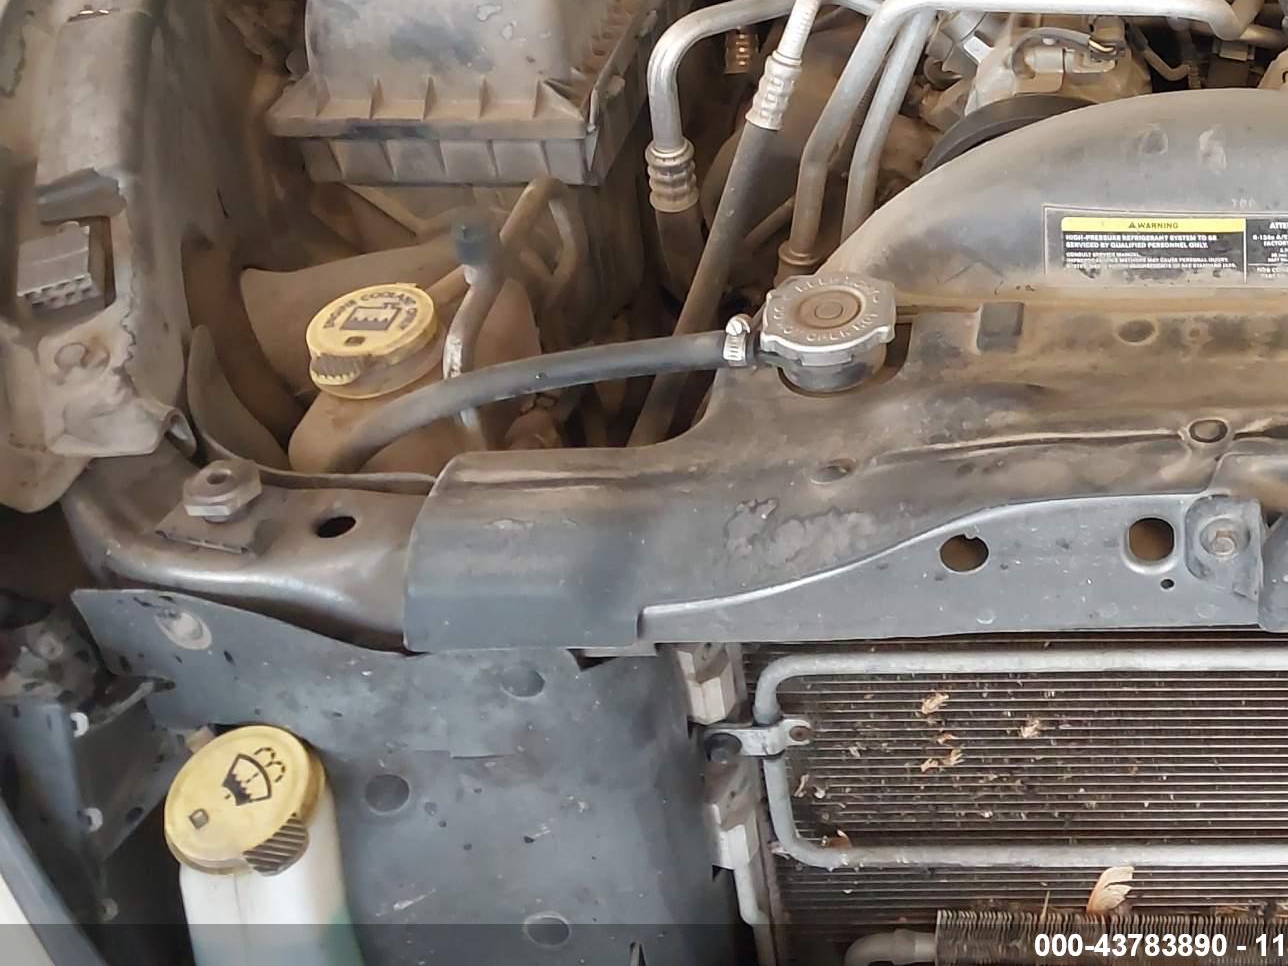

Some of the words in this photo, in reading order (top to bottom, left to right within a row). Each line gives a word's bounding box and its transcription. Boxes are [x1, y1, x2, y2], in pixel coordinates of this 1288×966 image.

[1138, 222, 1179, 230] WARNING
[1122, 234, 1169, 242] REFRIGERANT
[1110, 242, 1147, 250] QUALIFIED
